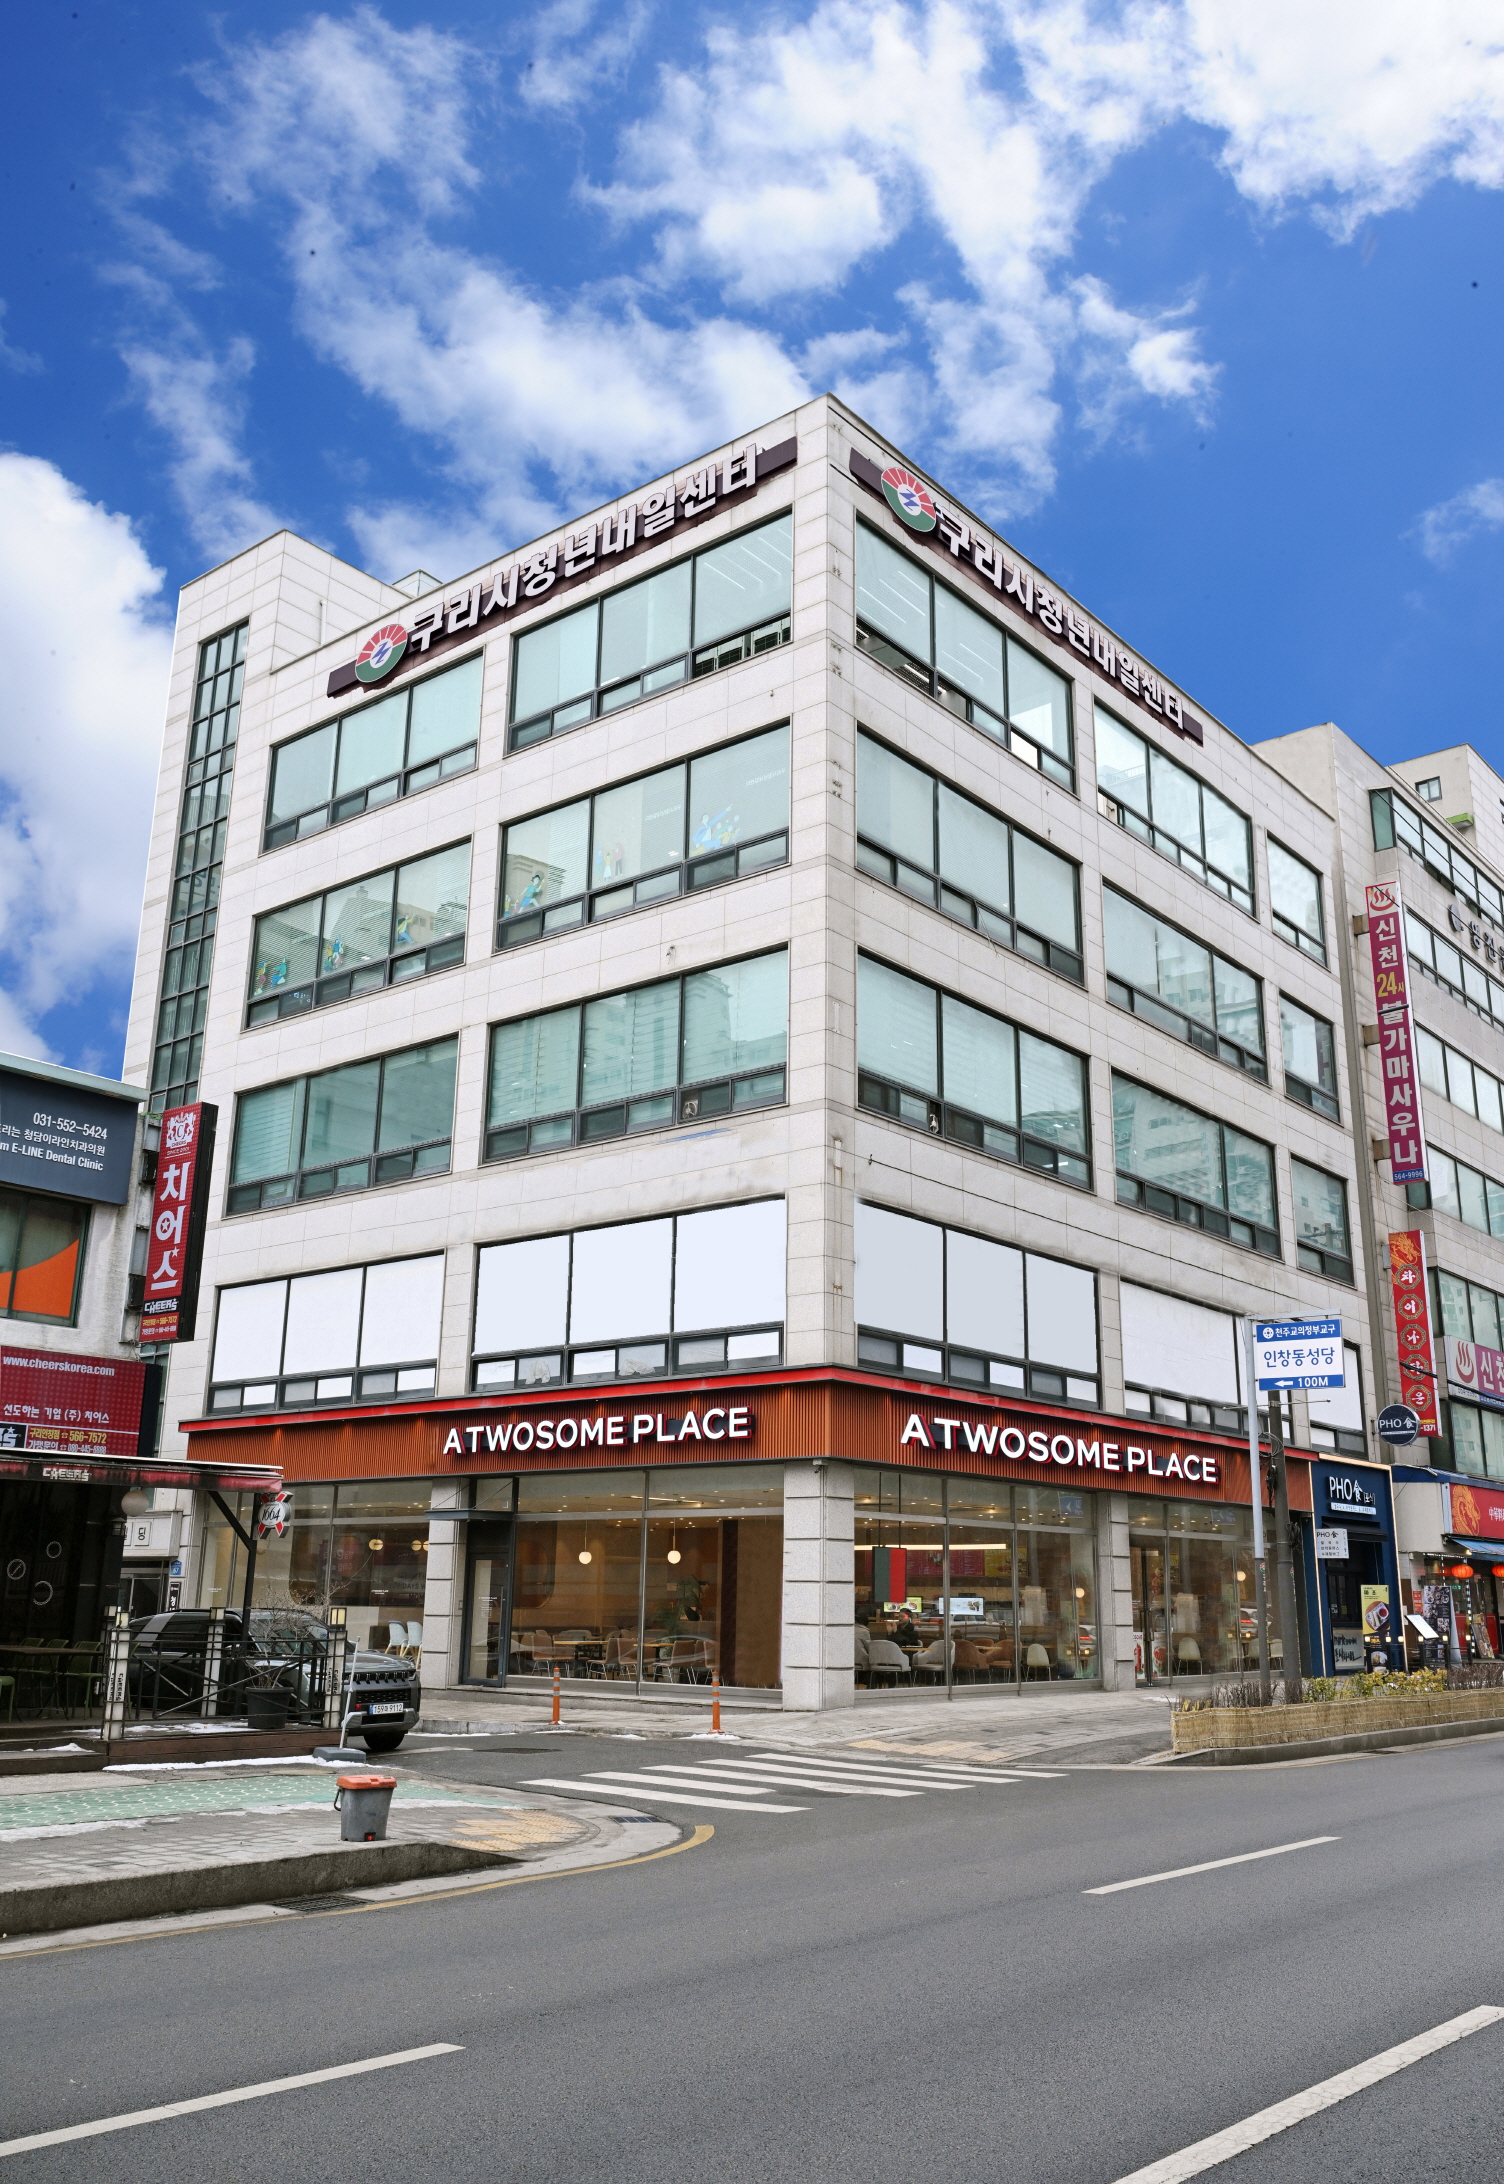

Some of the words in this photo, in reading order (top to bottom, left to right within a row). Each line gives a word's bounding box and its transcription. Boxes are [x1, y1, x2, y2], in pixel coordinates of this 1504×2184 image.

[410, 443, 757, 652] 구리시청년내일센터
[937, 506, 1184, 730] 구리시청년내일센터
[1376, 971, 1405, 998] 24시
[33, 1112, 108, 1140] 031-552-5424
[24, 1128, 105, 1157] 청담이라인치과의원
[11, 1142, 44, 1159] E-LINE
[45, 1149, 76, 1166] Dental
[77, 1156, 104, 1171] Clinic
[150, 1161, 192, 1292] 치어스
[144, 1298, 178, 1314] CHEERS
[1275, 1324, 1336, 1338] 천주교의정부교구
[3, 1355, 115, 1377] www.cheerskorea.com
[1263, 1346, 1335, 1368] 인창동성당
[1298, 1376, 1329, 1388] 100M
[3, 1404, 40, 1419] 선도하는
[44, 1407, 62, 1420] 기업
[64, 1408, 82, 1422] (주)
[84, 1410, 110, 1424] 치어스
[632, 1406, 750, 1444] PLACE
[69, 1430, 107, 1444] 566-7572
[1126, 1446, 1218, 1483] PLACE
